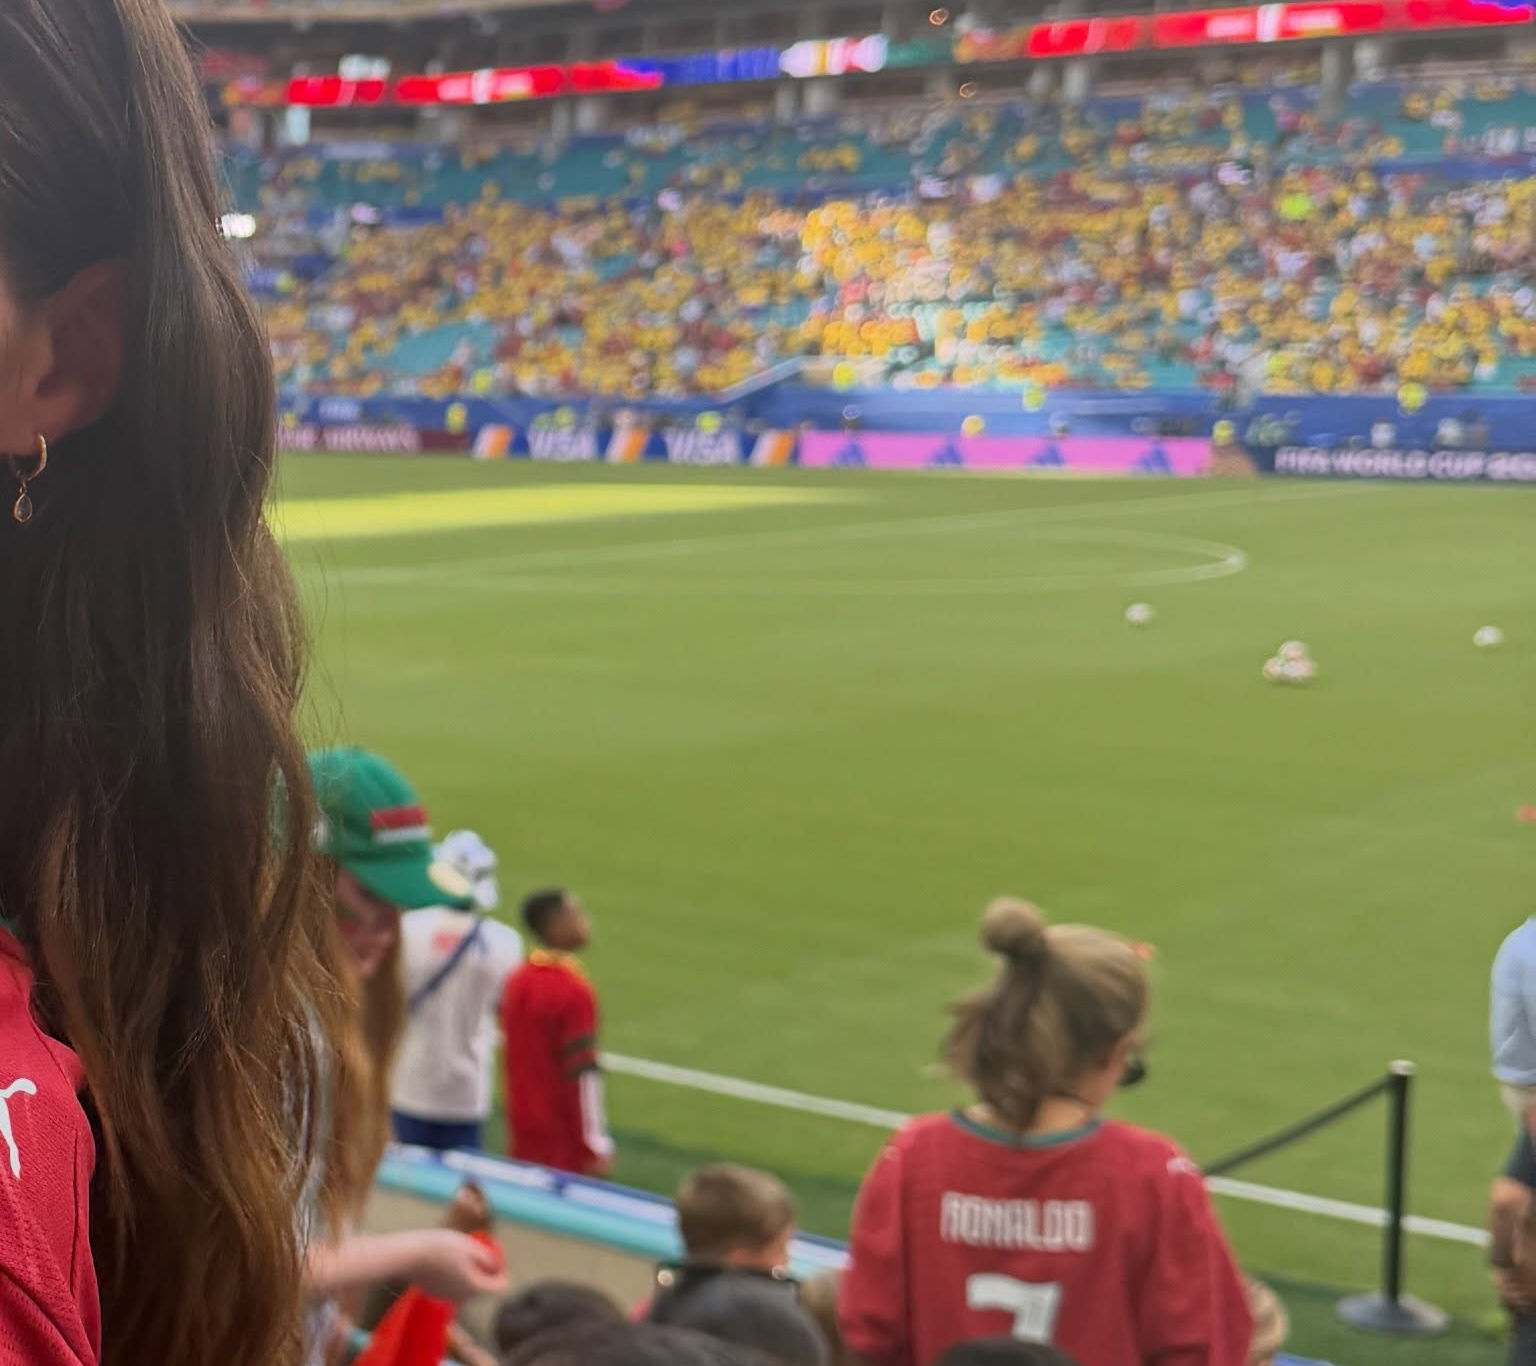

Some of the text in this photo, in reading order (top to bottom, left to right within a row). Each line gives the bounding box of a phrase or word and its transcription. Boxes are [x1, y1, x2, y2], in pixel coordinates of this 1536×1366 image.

[664, 428, 742, 466] VISA
[940, 1191, 1095, 1252] RONALDO
[966, 1272, 1062, 1344] 7
